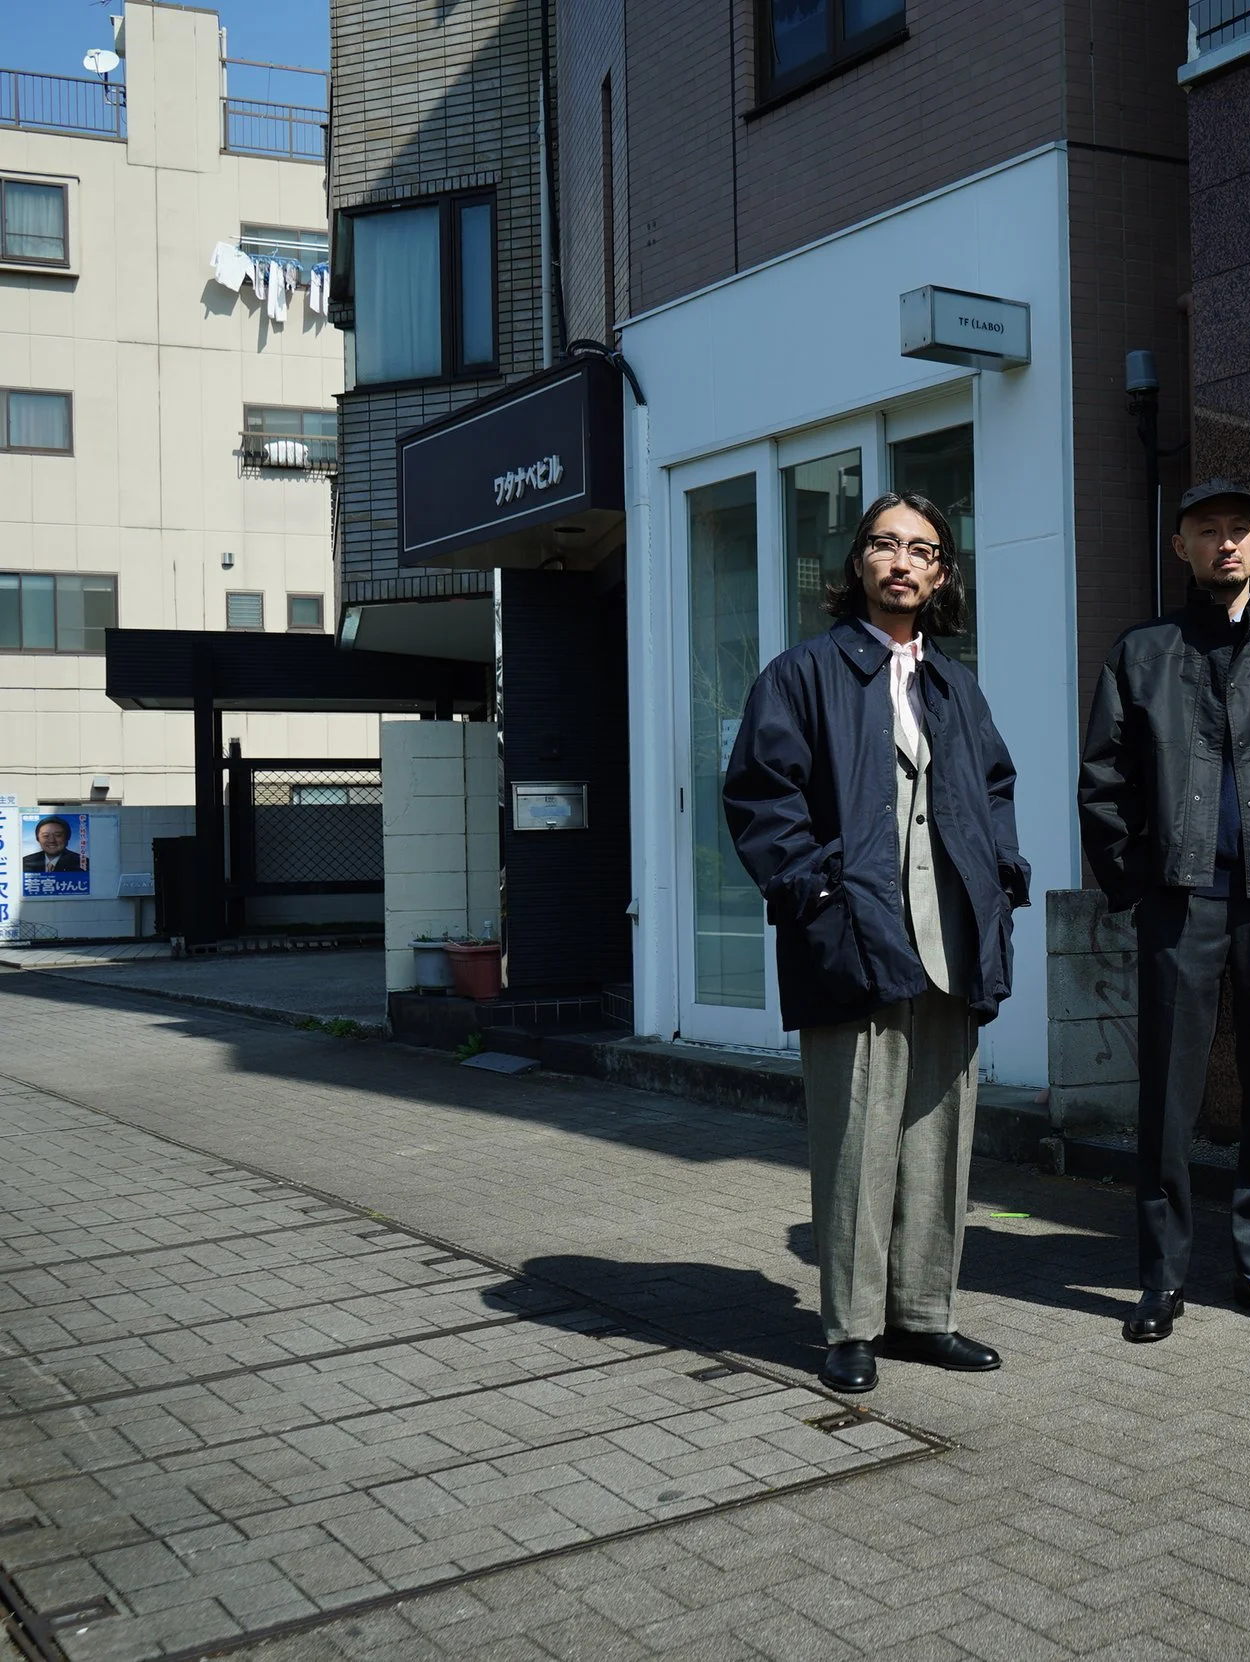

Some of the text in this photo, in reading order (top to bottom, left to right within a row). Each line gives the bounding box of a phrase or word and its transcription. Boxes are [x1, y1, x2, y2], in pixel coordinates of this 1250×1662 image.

[958, 317, 1005, 335] TF (LABO)
[494, 454, 563, 506] ワタナベビル
[24, 878, 88, 892] 若宮けんじ
